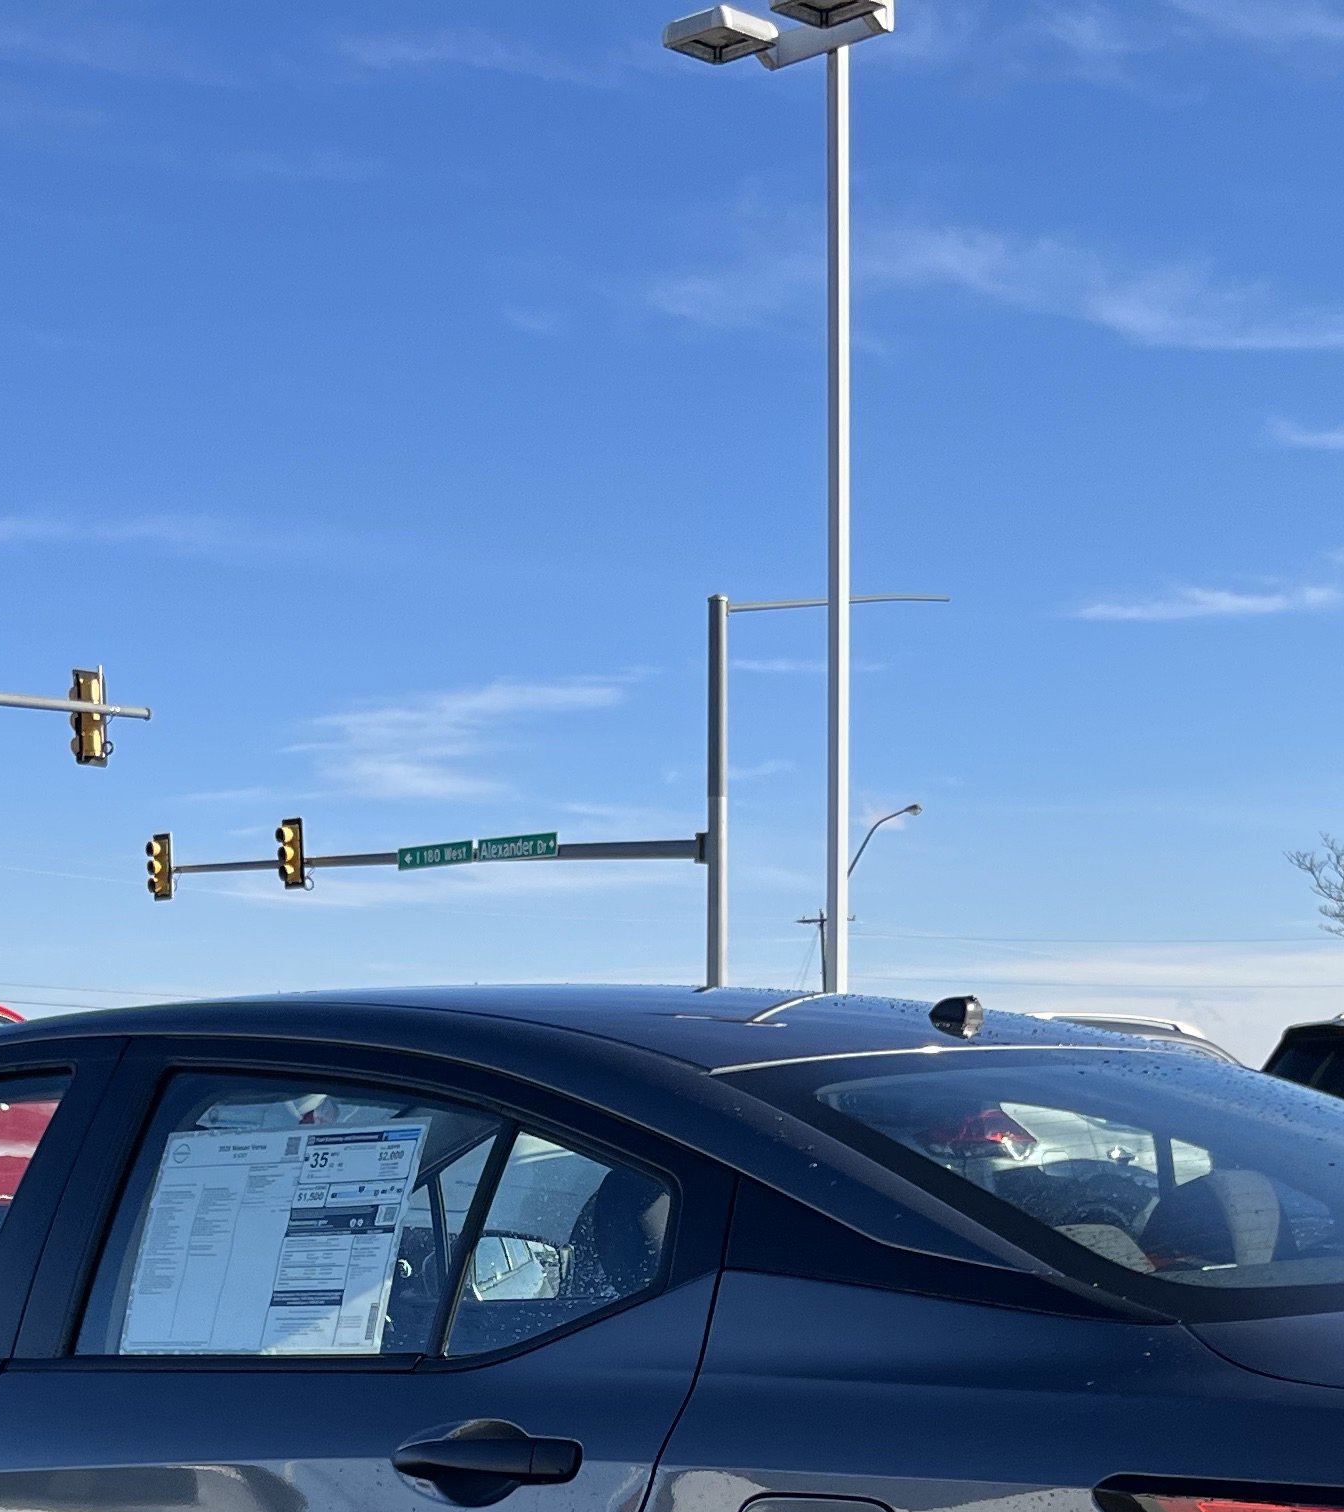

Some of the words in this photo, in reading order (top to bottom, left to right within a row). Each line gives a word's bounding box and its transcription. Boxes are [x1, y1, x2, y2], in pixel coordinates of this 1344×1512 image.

[424, 849, 441, 863] 180
[444, 847, 467, 861] West
[480, 838, 534, 860] Alexander
[537, 840, 547, 855] Dr
[310, 1152, 330, 1168] 35
